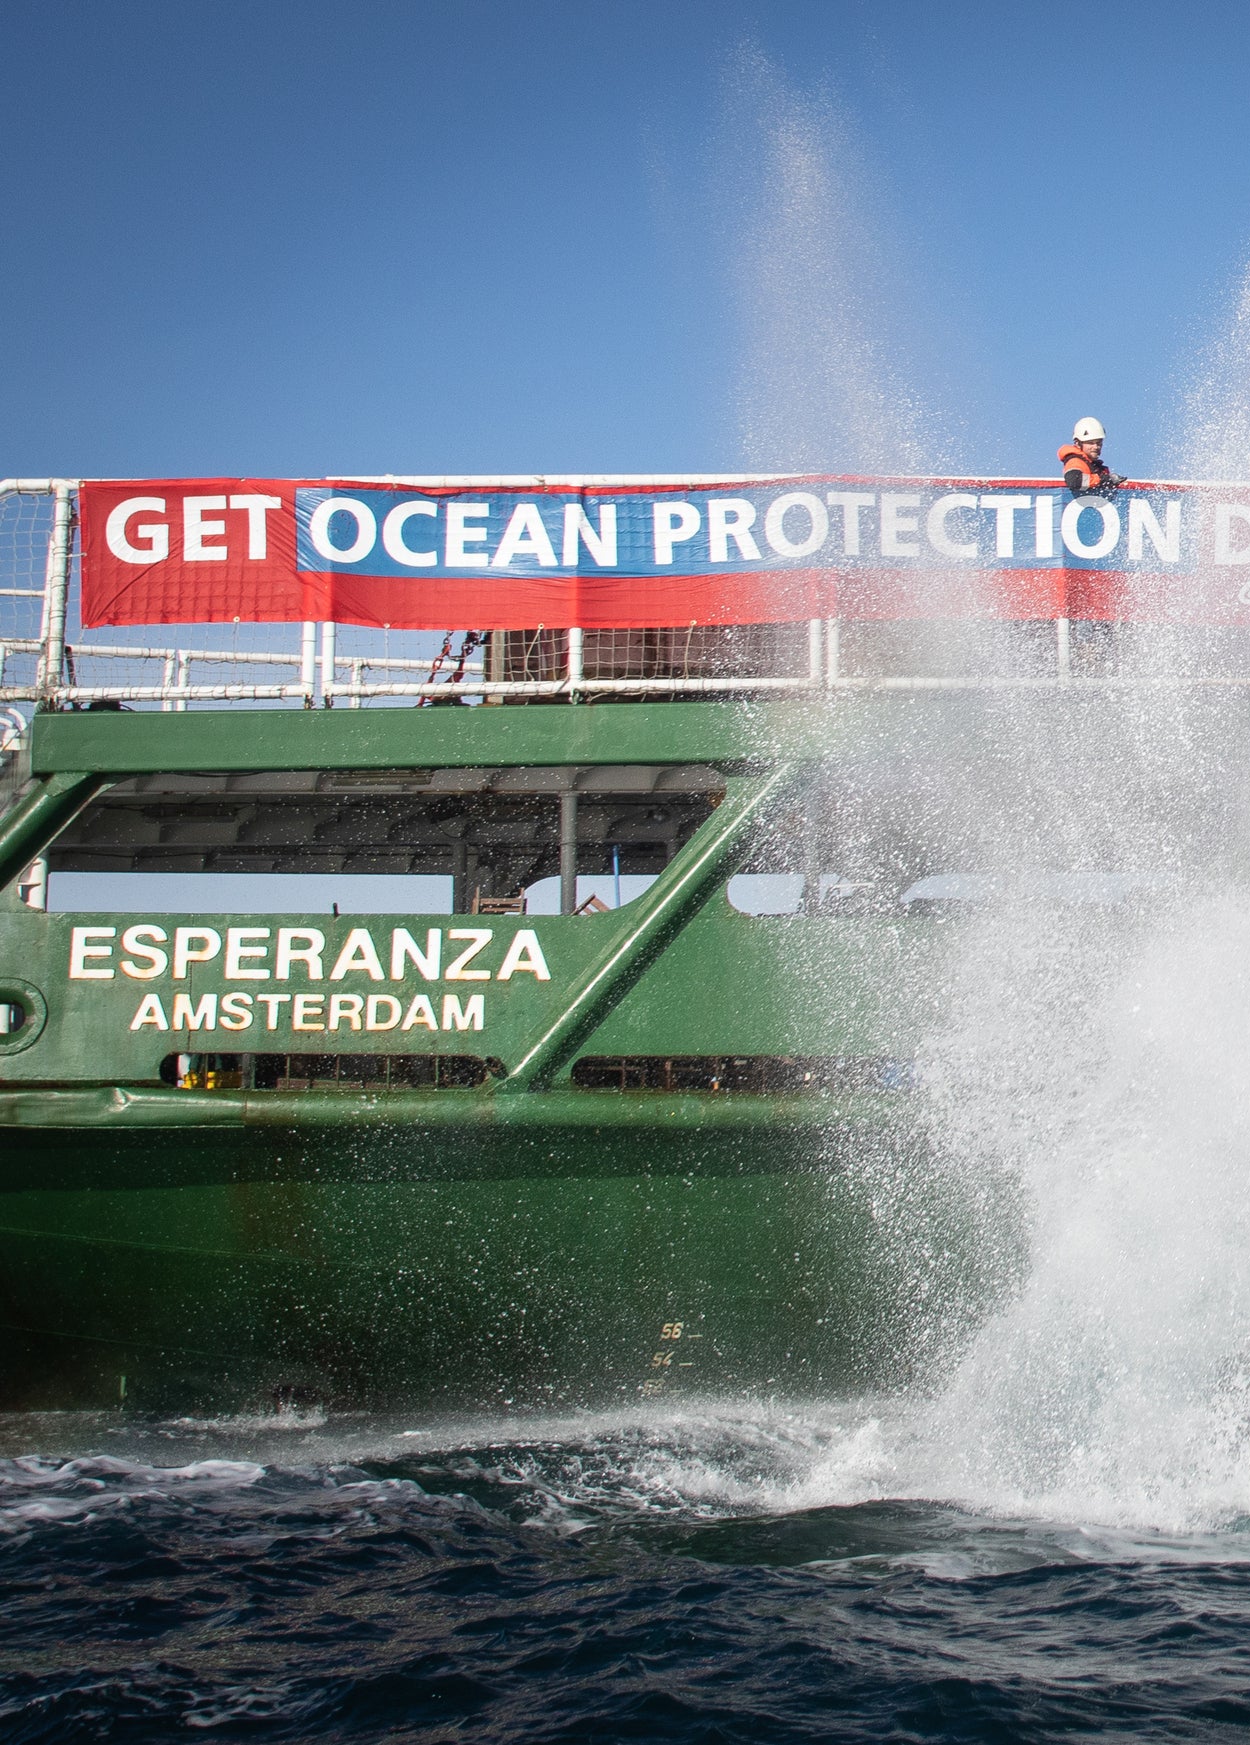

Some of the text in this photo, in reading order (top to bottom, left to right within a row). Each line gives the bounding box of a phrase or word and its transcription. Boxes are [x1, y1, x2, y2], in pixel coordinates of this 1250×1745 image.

[105, 494, 282, 565] GET
[309, 496, 619, 569] OCEAN
[654, 491, 1181, 565] PROTECTION
[68, 925, 552, 981] ESPERANZA
[130, 993, 486, 1032] AMSTERDAM
[660, 1322, 684, 1340] 56
